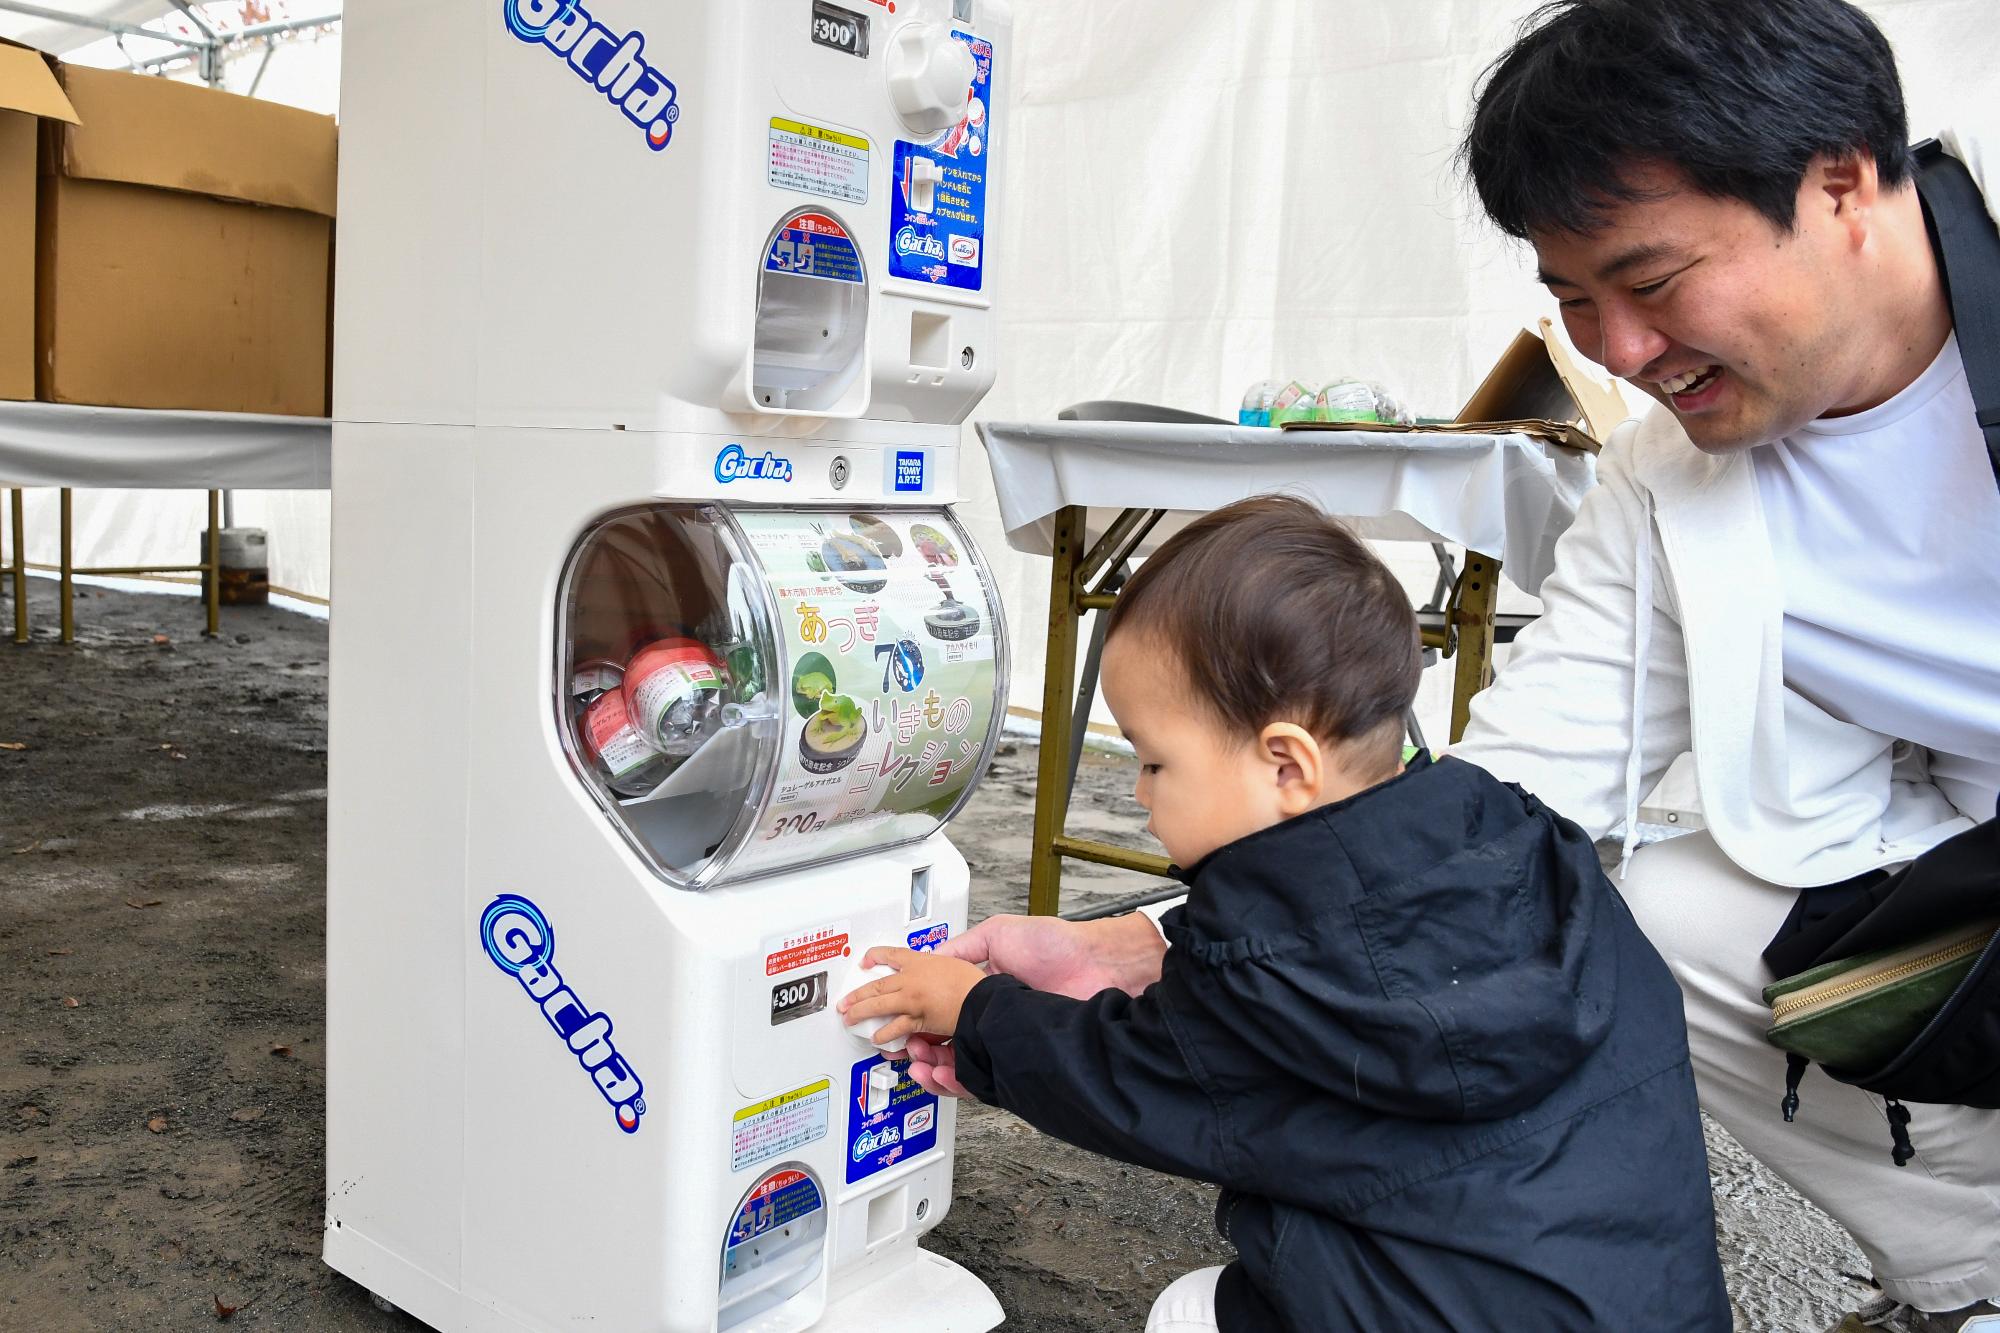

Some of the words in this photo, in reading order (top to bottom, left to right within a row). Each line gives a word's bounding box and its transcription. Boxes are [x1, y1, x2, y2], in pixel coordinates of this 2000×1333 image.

[898, 458, 921, 467] TAKARA
[898, 466, 921, 475] TOMY
[796, 601, 880, 654] あつぎ
[872, 690, 972, 744] いきもの
[849, 740, 980, 794] コレクション
